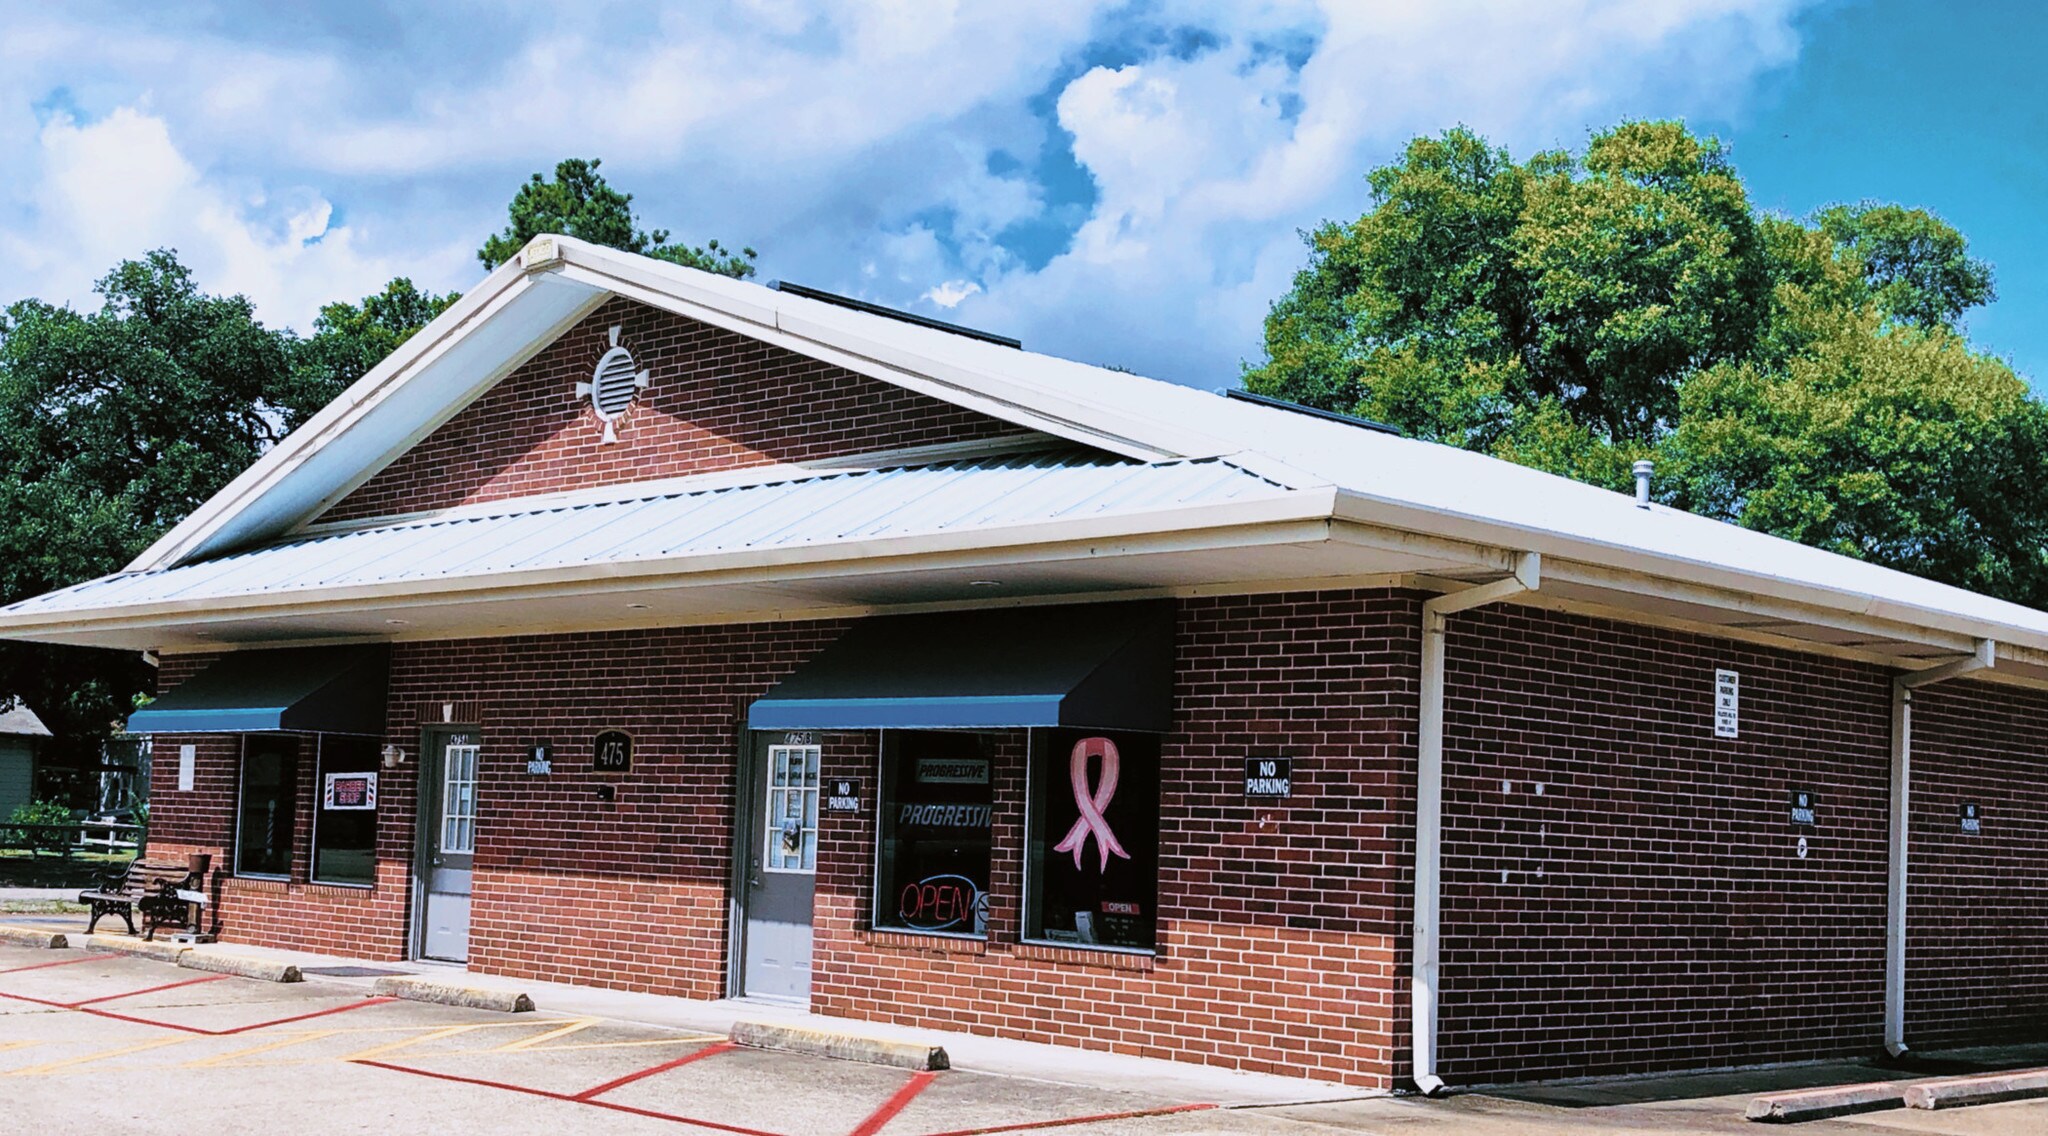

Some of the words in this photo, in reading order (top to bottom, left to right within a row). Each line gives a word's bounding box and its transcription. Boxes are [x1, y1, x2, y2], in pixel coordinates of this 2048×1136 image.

[535, 747, 545, 761] NO
[601, 742, 623, 765] 475
[527, 760, 551, 775] PARKING
[920, 764, 985, 778] PROGRESSIVE
[1260, 761, 1276, 777] NO
[335, 780, 366, 792] BARBER
[838, 782, 850, 796] NO
[1247, 778, 1289, 794] PARKING
[829, 796, 859, 810] PARKING
[1798, 794, 1808, 808] NO
[899, 804, 992, 828] PROGRESSIV
[1791, 807, 1814, 823] PARKING
[1967, 805, 1975, 817] NO
[1961, 818, 1980, 831] PARKING
[901, 883, 972, 922] OPEN
[1108, 902, 1133, 913] OPEN
